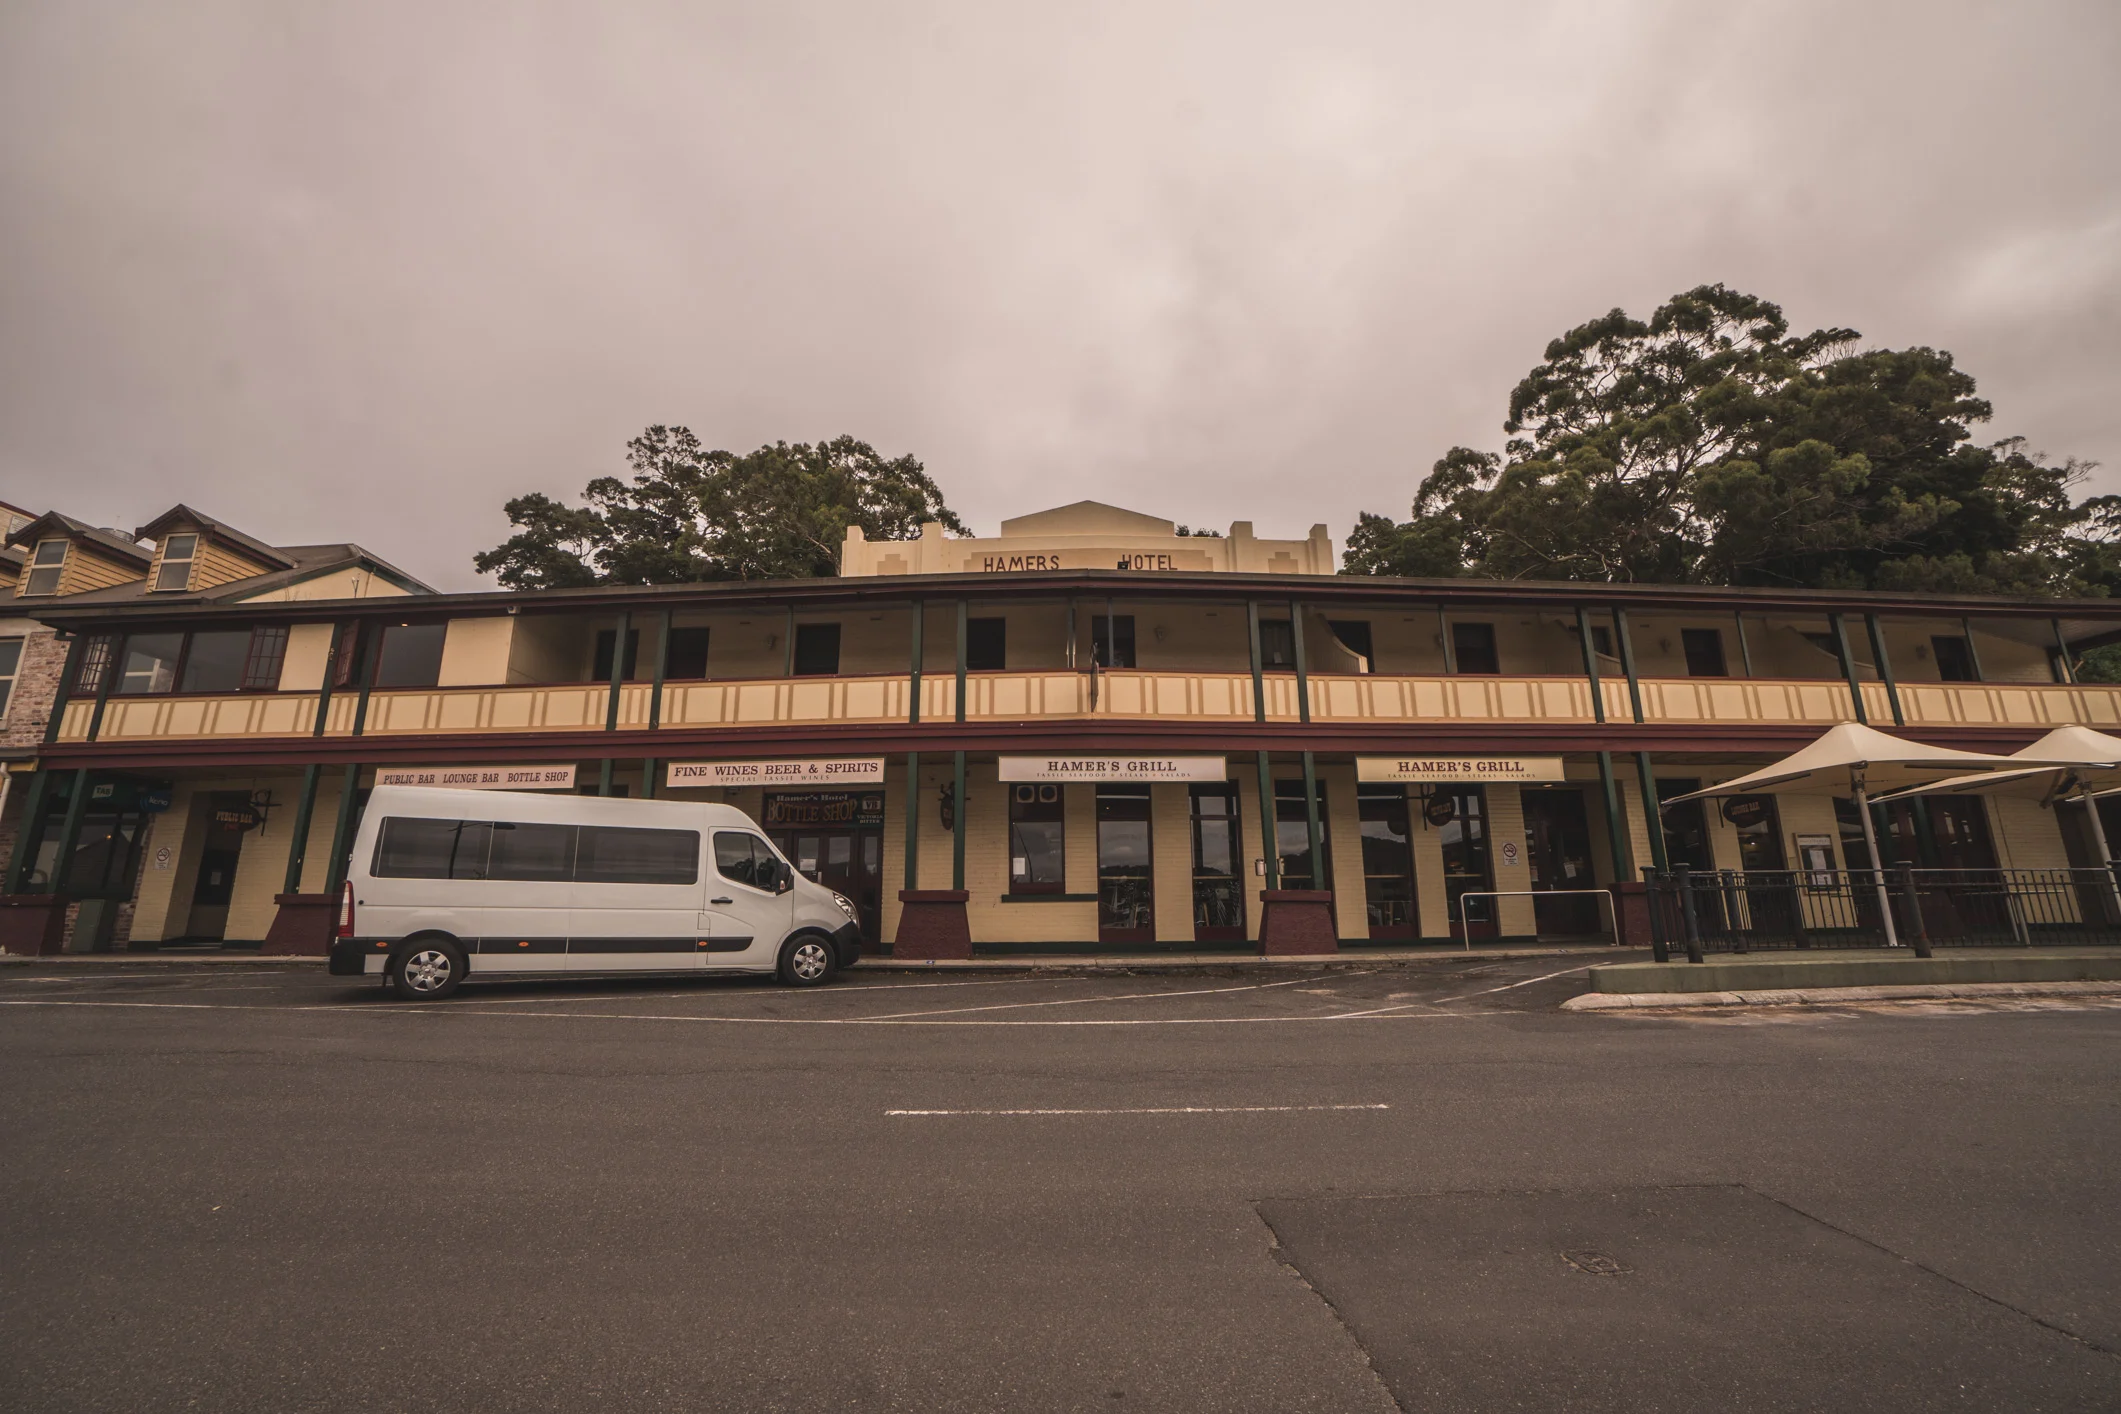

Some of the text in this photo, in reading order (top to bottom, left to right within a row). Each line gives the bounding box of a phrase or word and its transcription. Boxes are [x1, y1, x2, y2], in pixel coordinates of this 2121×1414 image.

[985, 554, 1178, 572] HAMERS HOTEL
[674, 762, 879, 777] FINE WINES BEER & SPIRITS
[1048, 762, 1177, 772] HAMER'S GRILL
[1398, 761, 1525, 772] HAMER'S GRILL
[383, 774, 436, 785] PUBLIC BAR
[442, 773, 500, 784] LOUNGE BAR
[507, 771, 569, 783] BOTTLE SHOP
[96, 786, 111, 796] TAB
[768, 799, 857, 821] BOTTLE SHOP
[216, 811, 239, 823] PUBLIC
